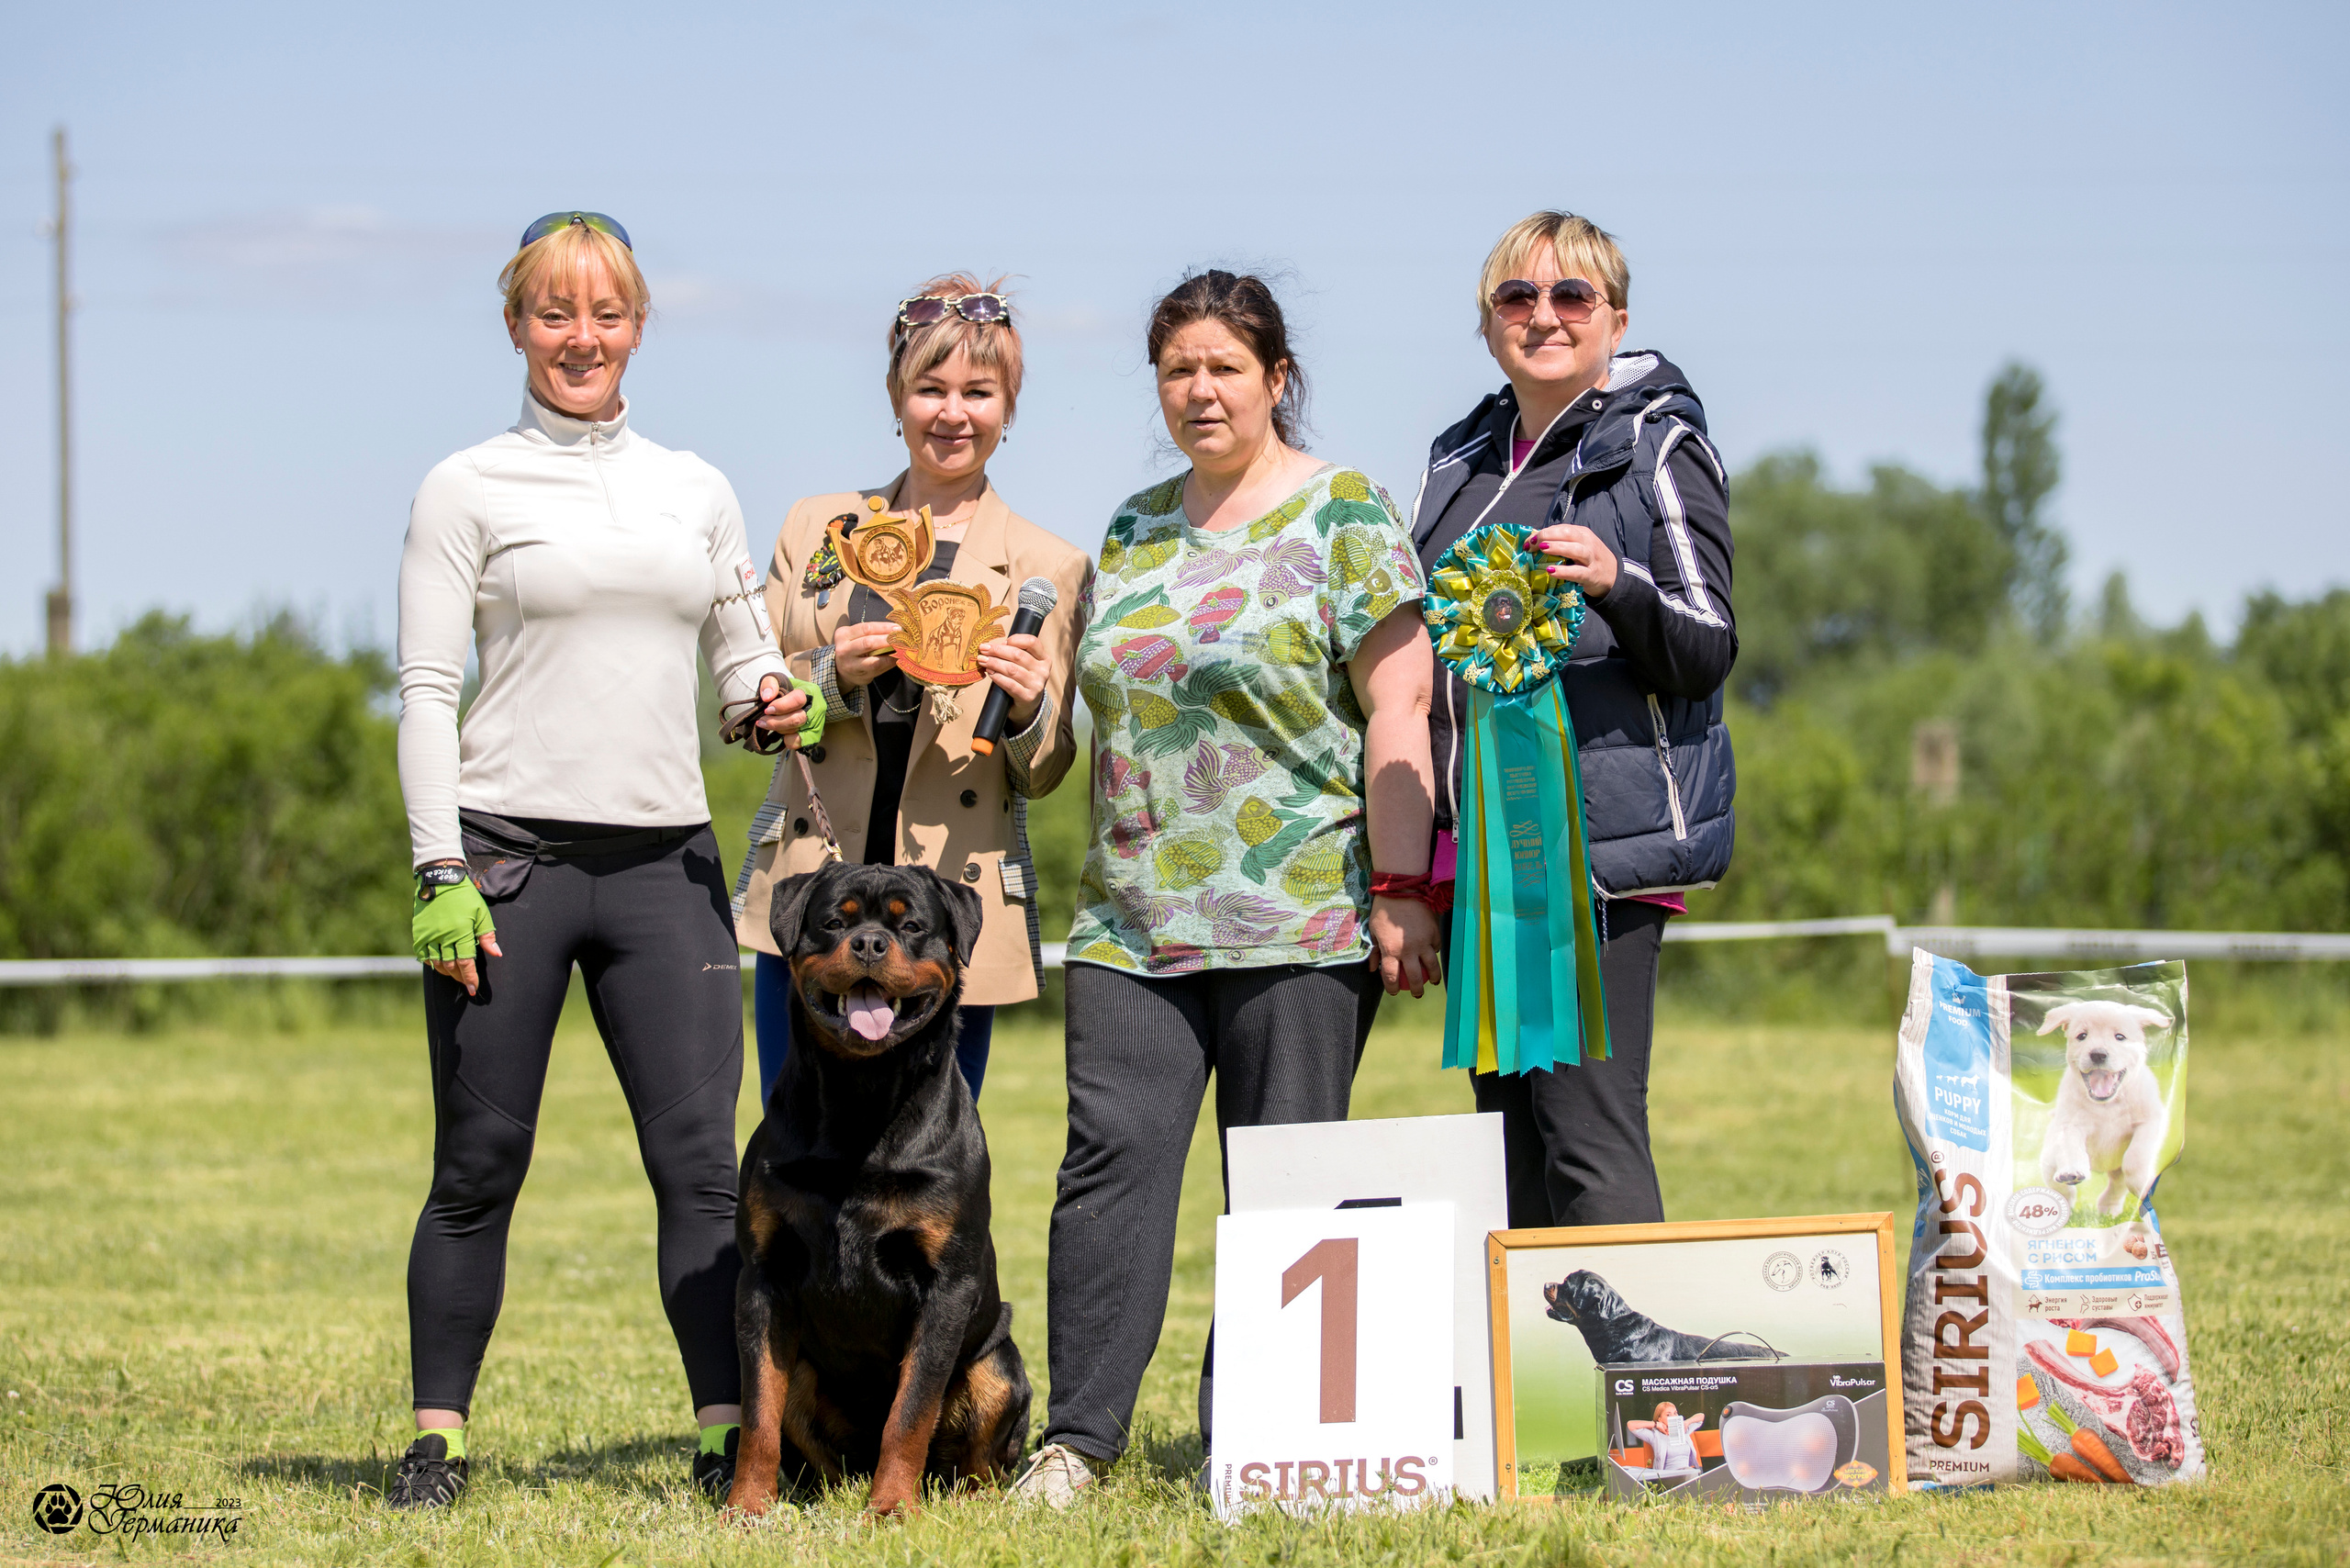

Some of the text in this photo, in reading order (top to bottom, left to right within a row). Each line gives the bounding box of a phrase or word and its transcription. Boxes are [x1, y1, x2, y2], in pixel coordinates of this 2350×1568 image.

[1939, 1000, 1981, 1017] PREMIUM
[1948, 1014, 1968, 1026] FOOD
[1934, 1085, 1982, 1114] PUPPY
[1943, 1108, 1972, 1124] КОРМ ДЛЯ
[1950, 1127, 1967, 1138] СОБАК
[1958, 1122, 1986, 1137] МОЛОДЫХ
[2019, 1204, 2058, 1219] 48%
[2027, 1238, 2097, 1249] ЯГНЕНОК
[2042, 1251, 2098, 1263] РИСОМ
[2044, 1273, 2084, 1283] Комплекс
[2085, 1272, 2132, 1284] пробиотиков
[2044, 1296, 2067, 1305] Энергия
[2091, 1295, 2118, 1304] Здоровые
[1281, 1238, 1359, 1424] 1
[1615, 1379, 1634, 1393] CS
[1641, 1376, 1738, 1386] МАССАЖНАЯ ПОДУШКА
[1830, 1378, 1876, 1387] VibraPulsar
[1929, 1460, 1990, 1473] PREMIUM
